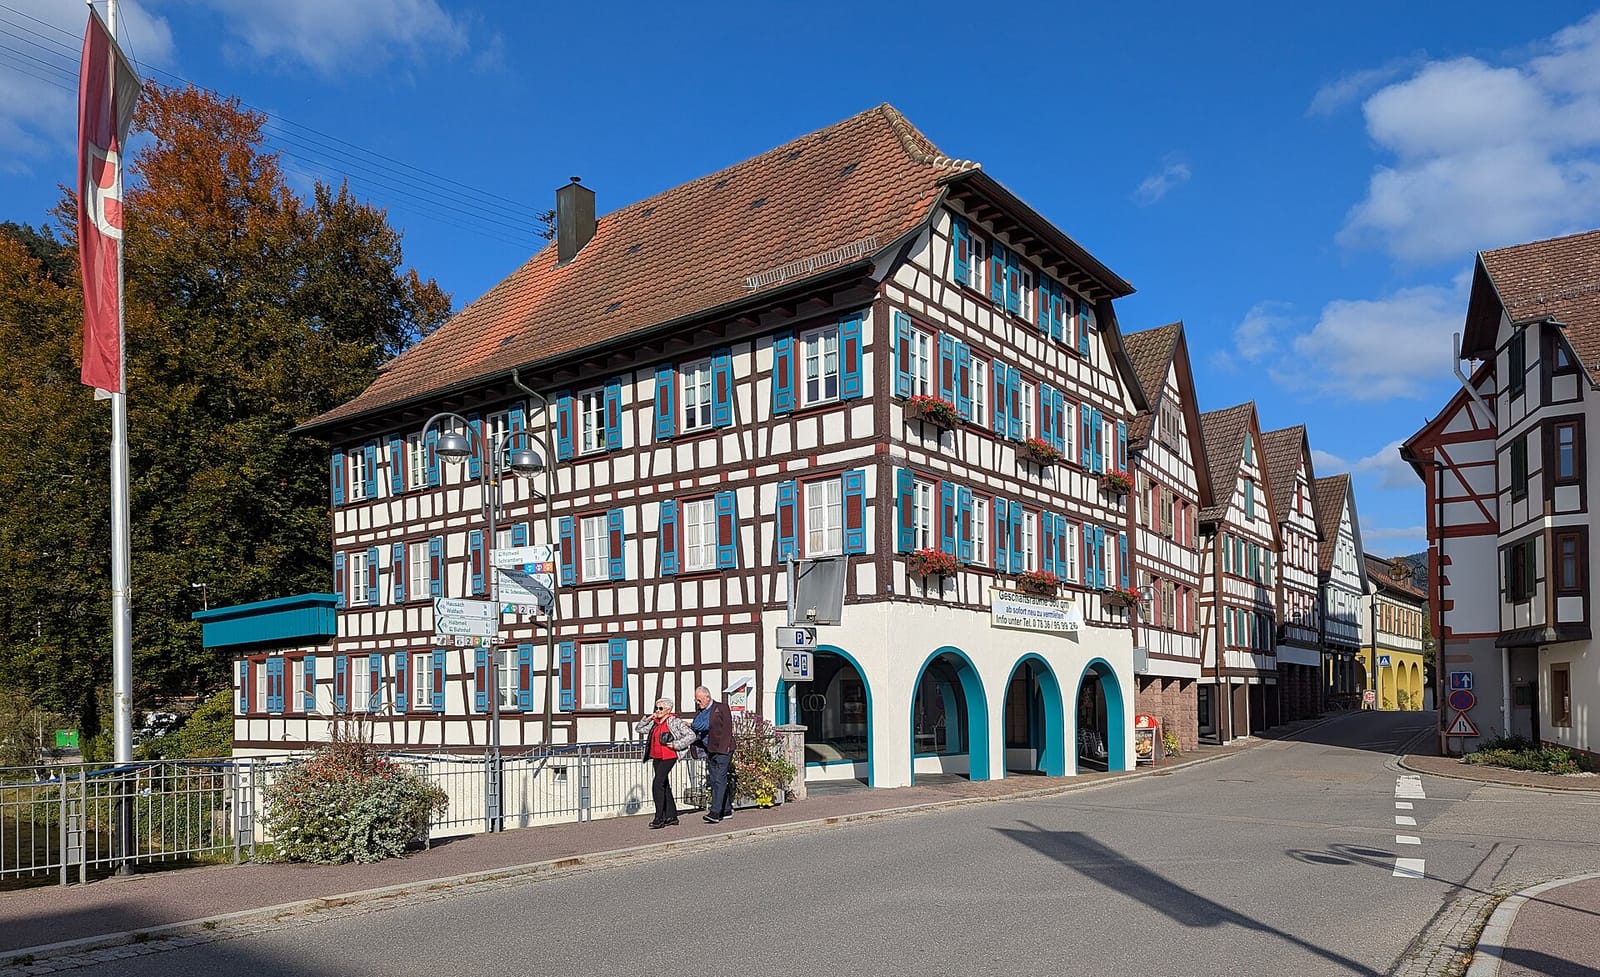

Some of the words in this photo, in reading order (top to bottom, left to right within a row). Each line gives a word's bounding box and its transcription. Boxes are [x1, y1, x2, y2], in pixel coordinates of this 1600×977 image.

[1013, 606, 1027, 616] sofort
[1027, 609, 1036, 617] neu
[996, 614, 1007, 624] Info
[1008, 617, 1022, 626] unter
